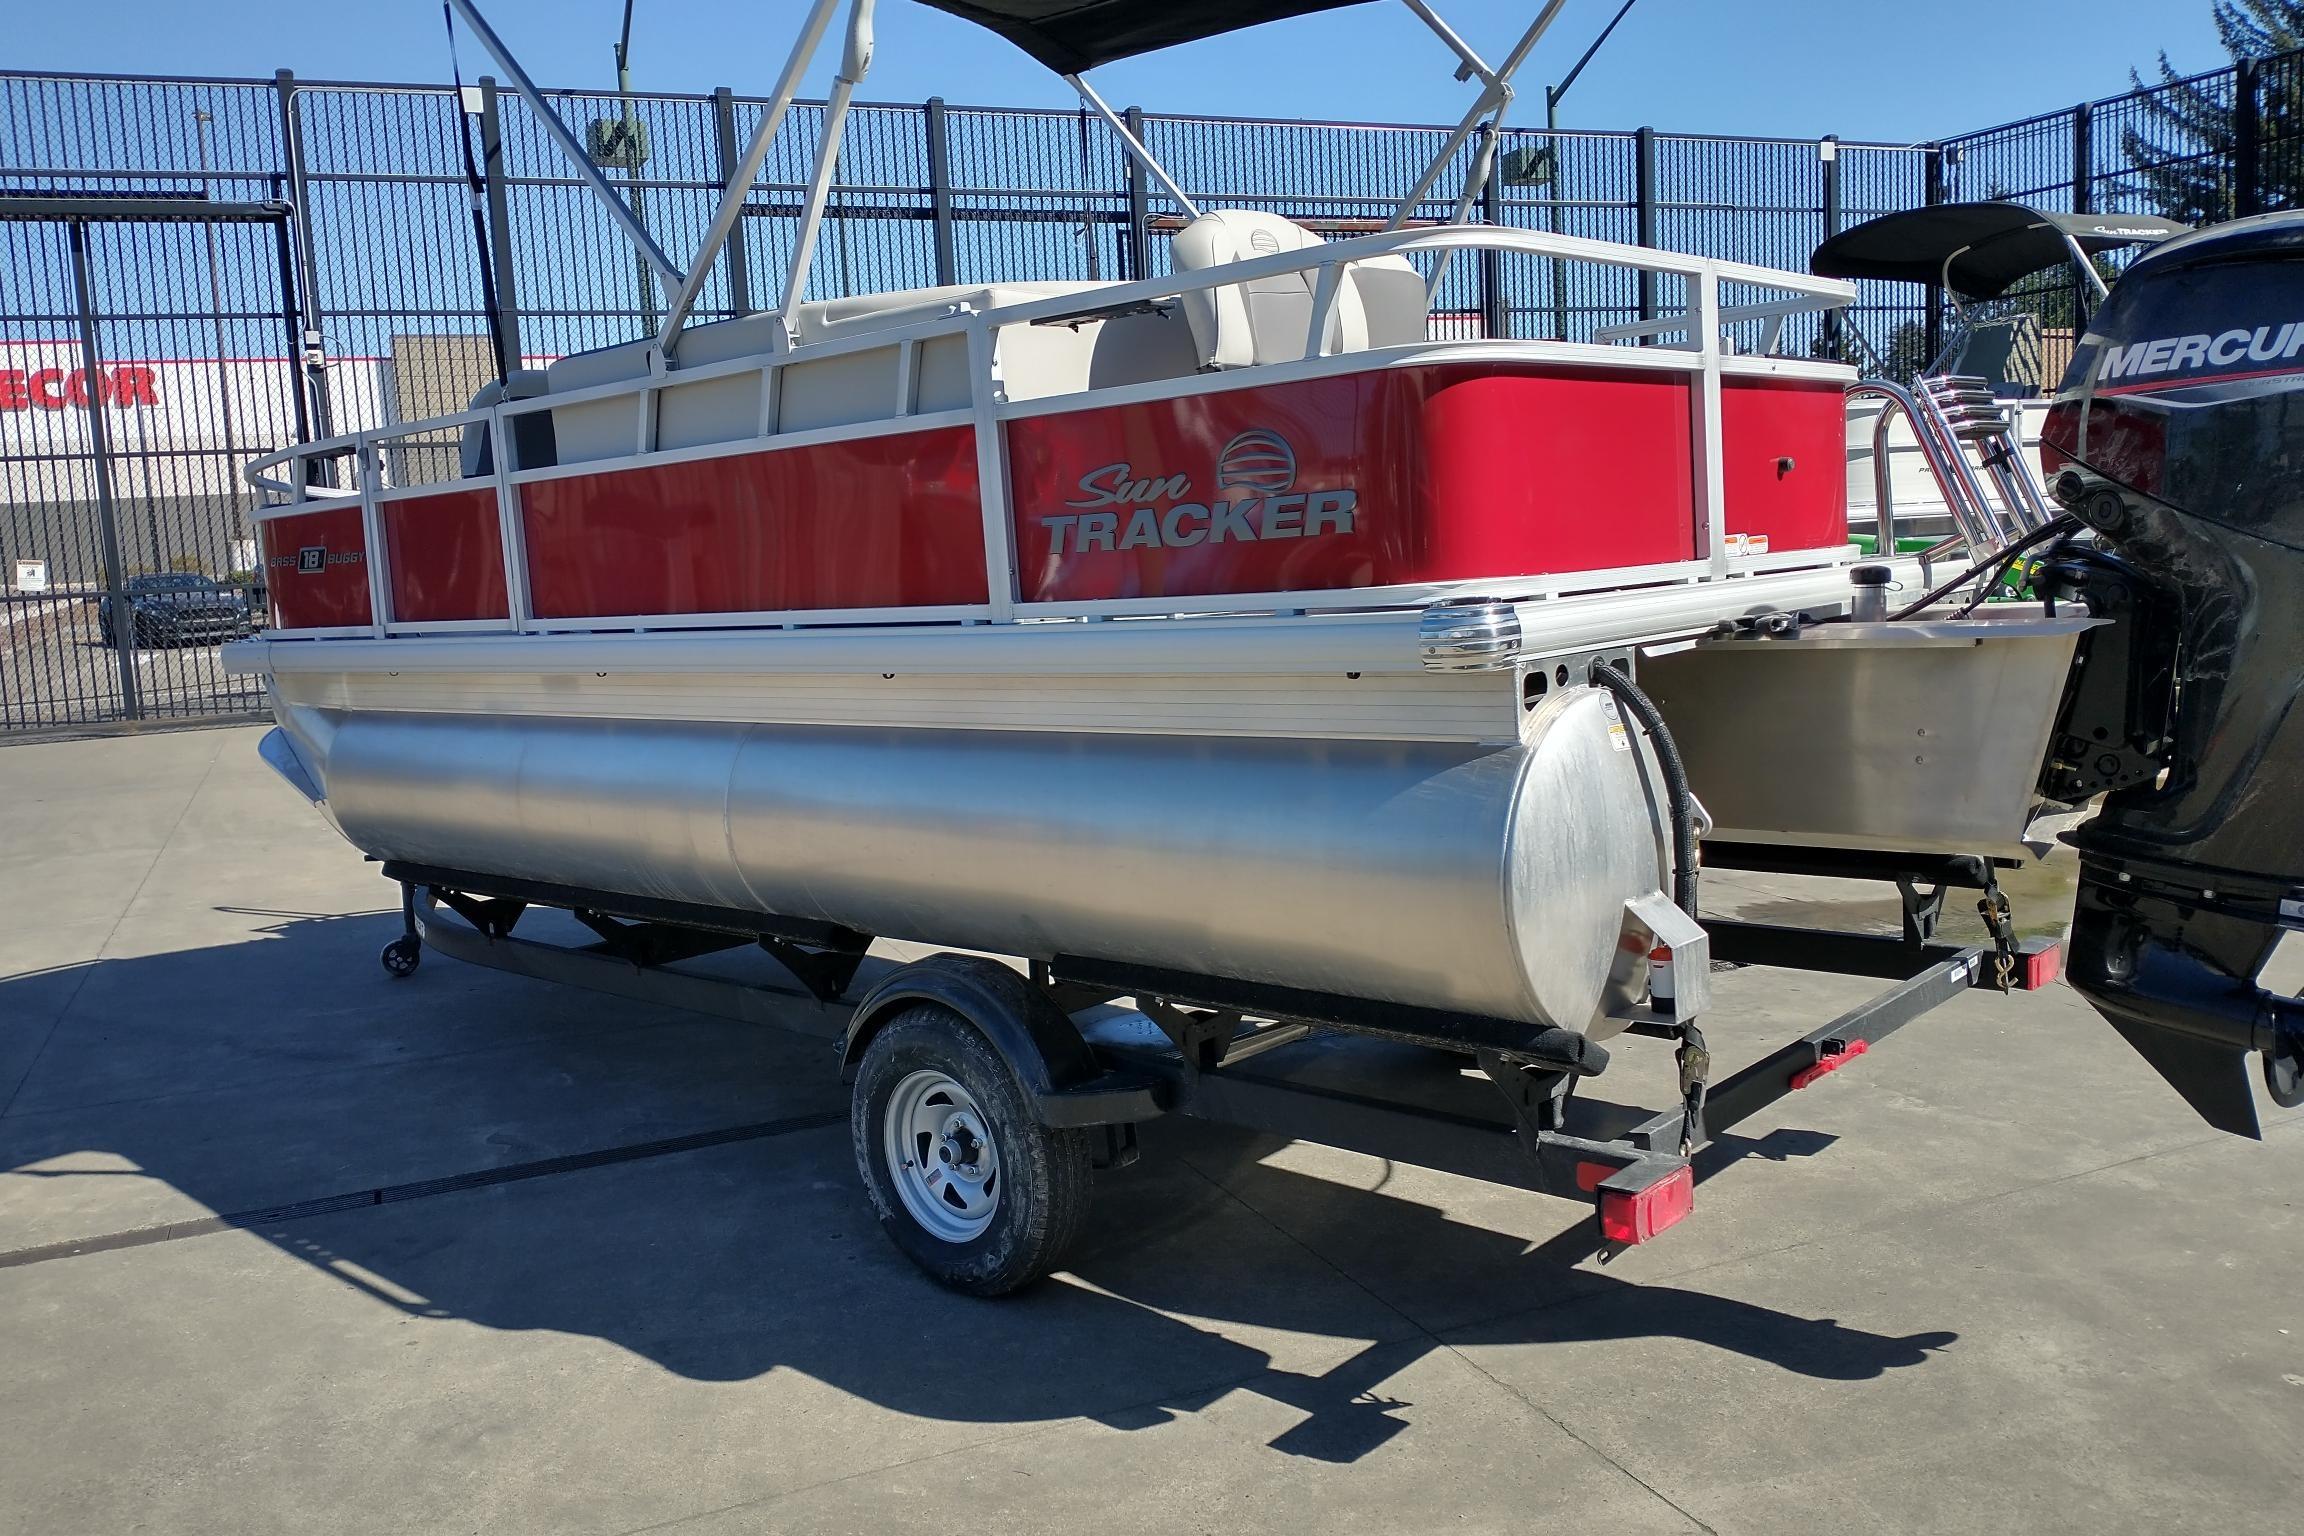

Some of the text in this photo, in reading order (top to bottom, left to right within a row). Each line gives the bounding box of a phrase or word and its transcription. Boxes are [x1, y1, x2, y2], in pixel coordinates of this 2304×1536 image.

[2117, 227, 2169, 236] TRACKER
[1065, 463, 1193, 507] Sun
[1041, 489, 1359, 554] TRACKER
[270, 551, 366, 569] BASS 18 BUGGY
